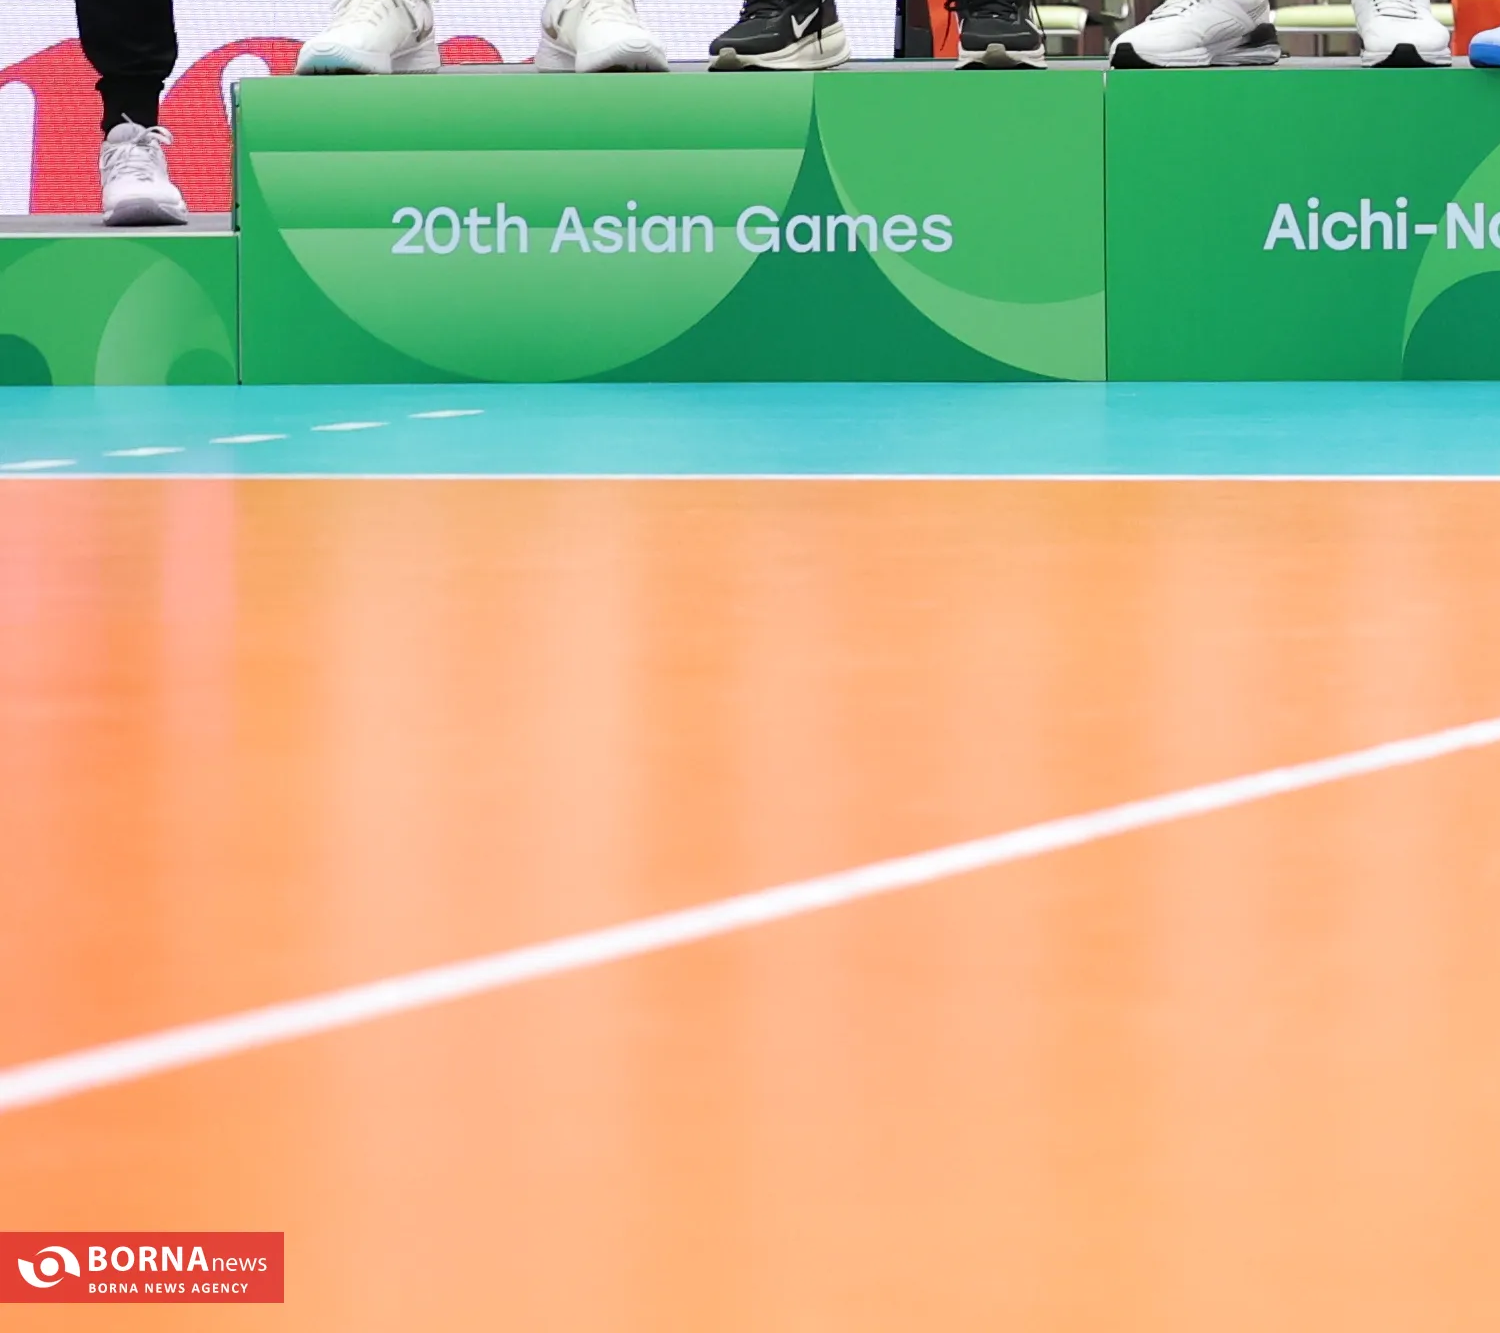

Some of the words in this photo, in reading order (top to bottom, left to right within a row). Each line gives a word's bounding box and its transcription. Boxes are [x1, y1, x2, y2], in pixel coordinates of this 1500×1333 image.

[392, 203, 528, 254] 20th
[551, 201, 714, 253] Asian
[739, 205, 953, 253] Games
